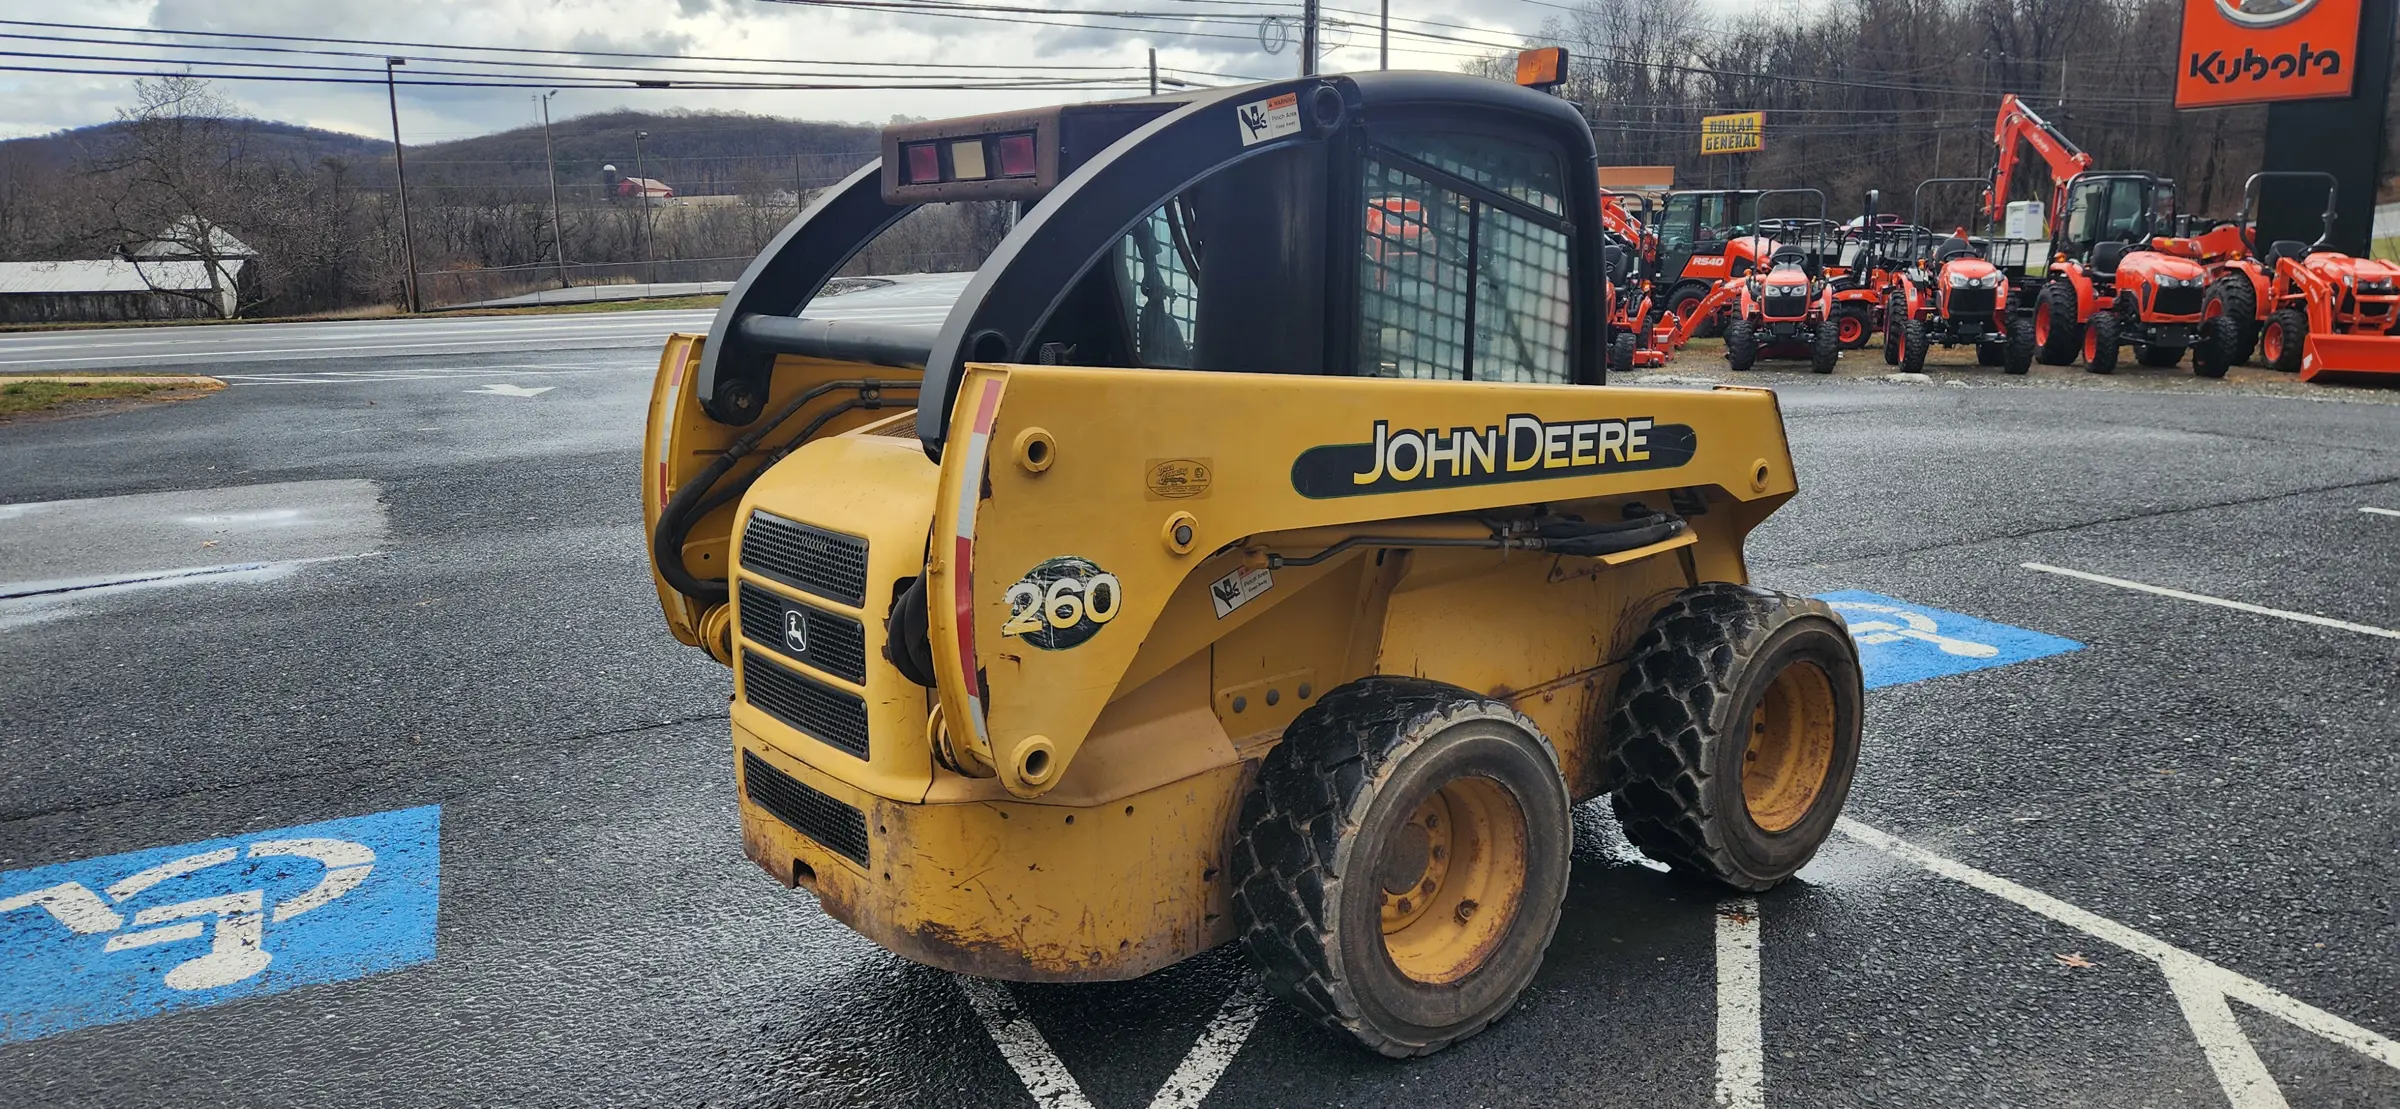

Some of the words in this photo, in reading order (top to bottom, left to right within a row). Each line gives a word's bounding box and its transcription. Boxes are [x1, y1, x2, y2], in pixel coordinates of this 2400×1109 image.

[2188, 41, 2342, 85] Kubota
[1273, 95, 1296, 105] WARNING
[1271, 113, 1285, 121] Pinch
[1709, 117, 1754, 133] DOLLAR
[1705, 133, 1757, 151] GENERAL
[1692, 256, 1725, 266] RS40
[1352, 421, 1497, 486] JOHN
[1505, 414, 1654, 473] DEERE
[1243, 575, 1257, 587] Pinch
[1257, 570, 1268, 579] Area
[1002, 571, 1122, 637] 260
